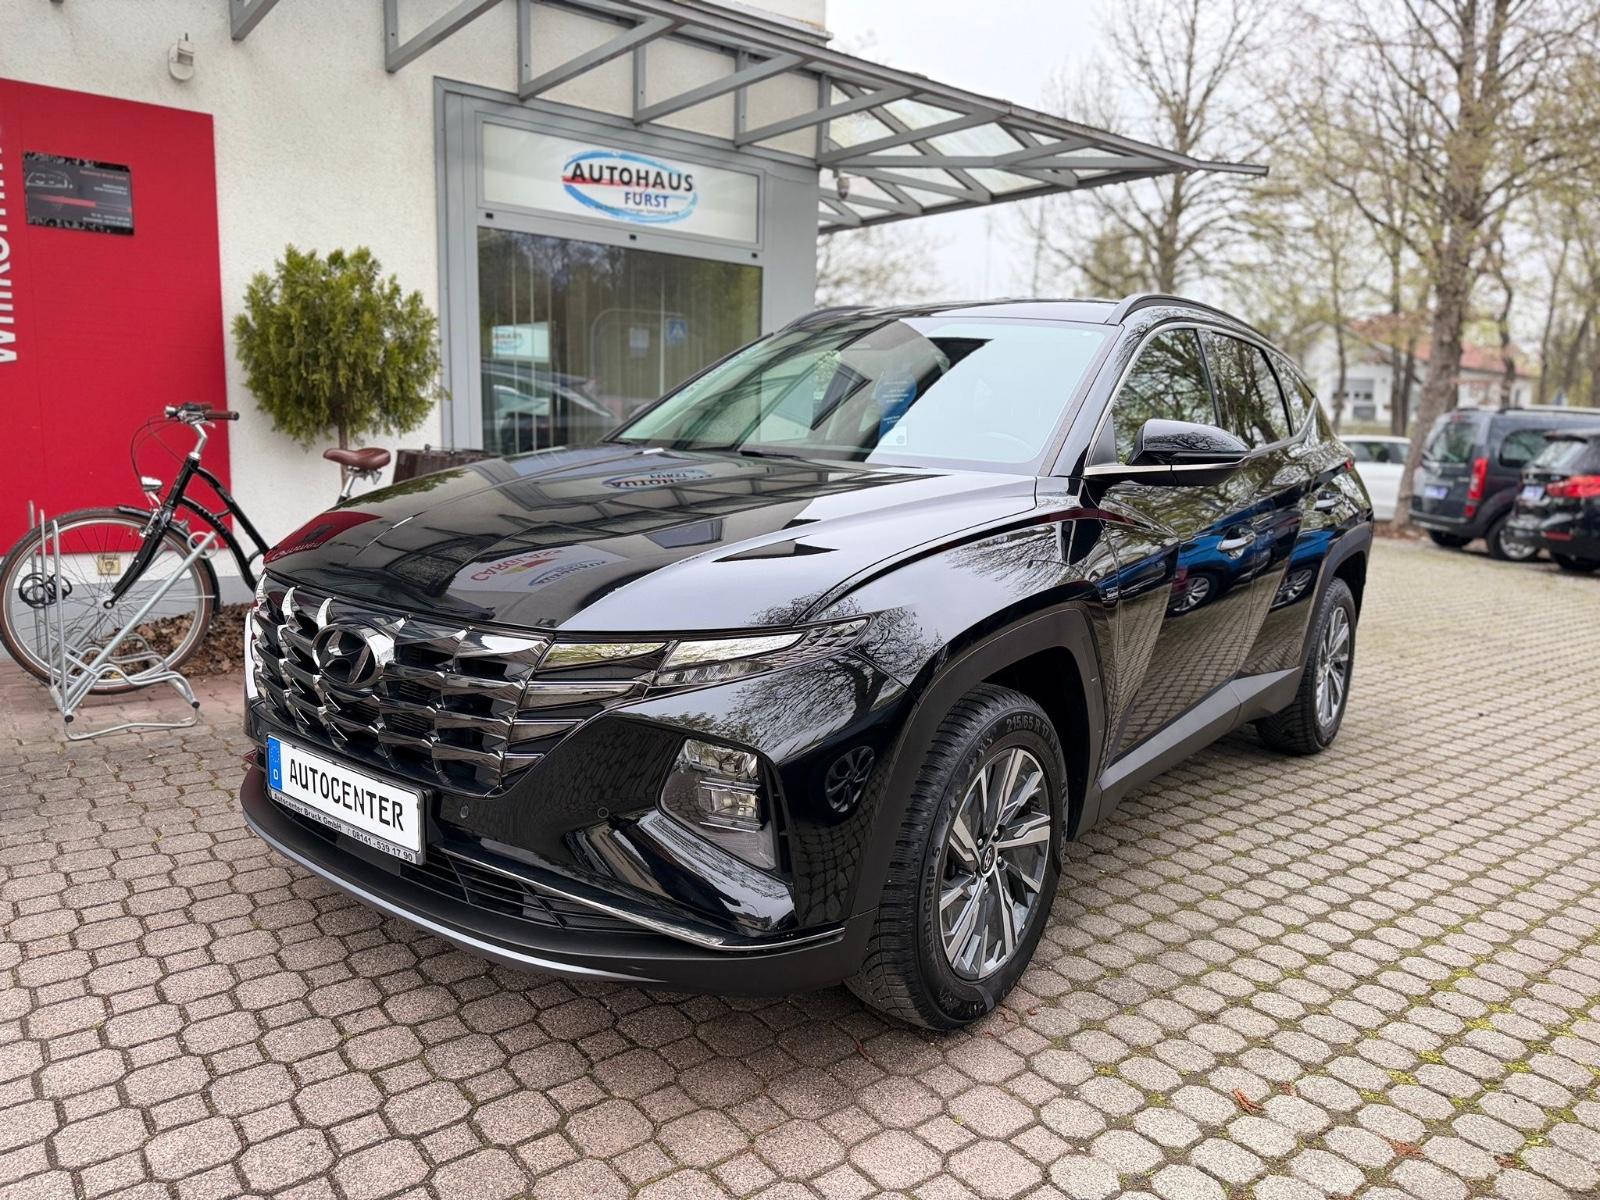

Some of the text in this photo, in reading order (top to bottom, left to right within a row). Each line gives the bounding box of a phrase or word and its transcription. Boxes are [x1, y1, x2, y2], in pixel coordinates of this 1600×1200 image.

[571, 162, 694, 192] AUTOHAUS
[273, 769, 279, 780] D
[290, 758, 404, 832] AUTOCENTER
[274, 793, 303, 814] Autocenter
[303, 808, 322, 823] Bruck
[323, 816, 342, 831] GmbH
[352, 829, 372, 845] 08141
[376, 840, 390, 853] 539
[392, 846, 401, 857] 17
[403, 851, 413, 862] 90
